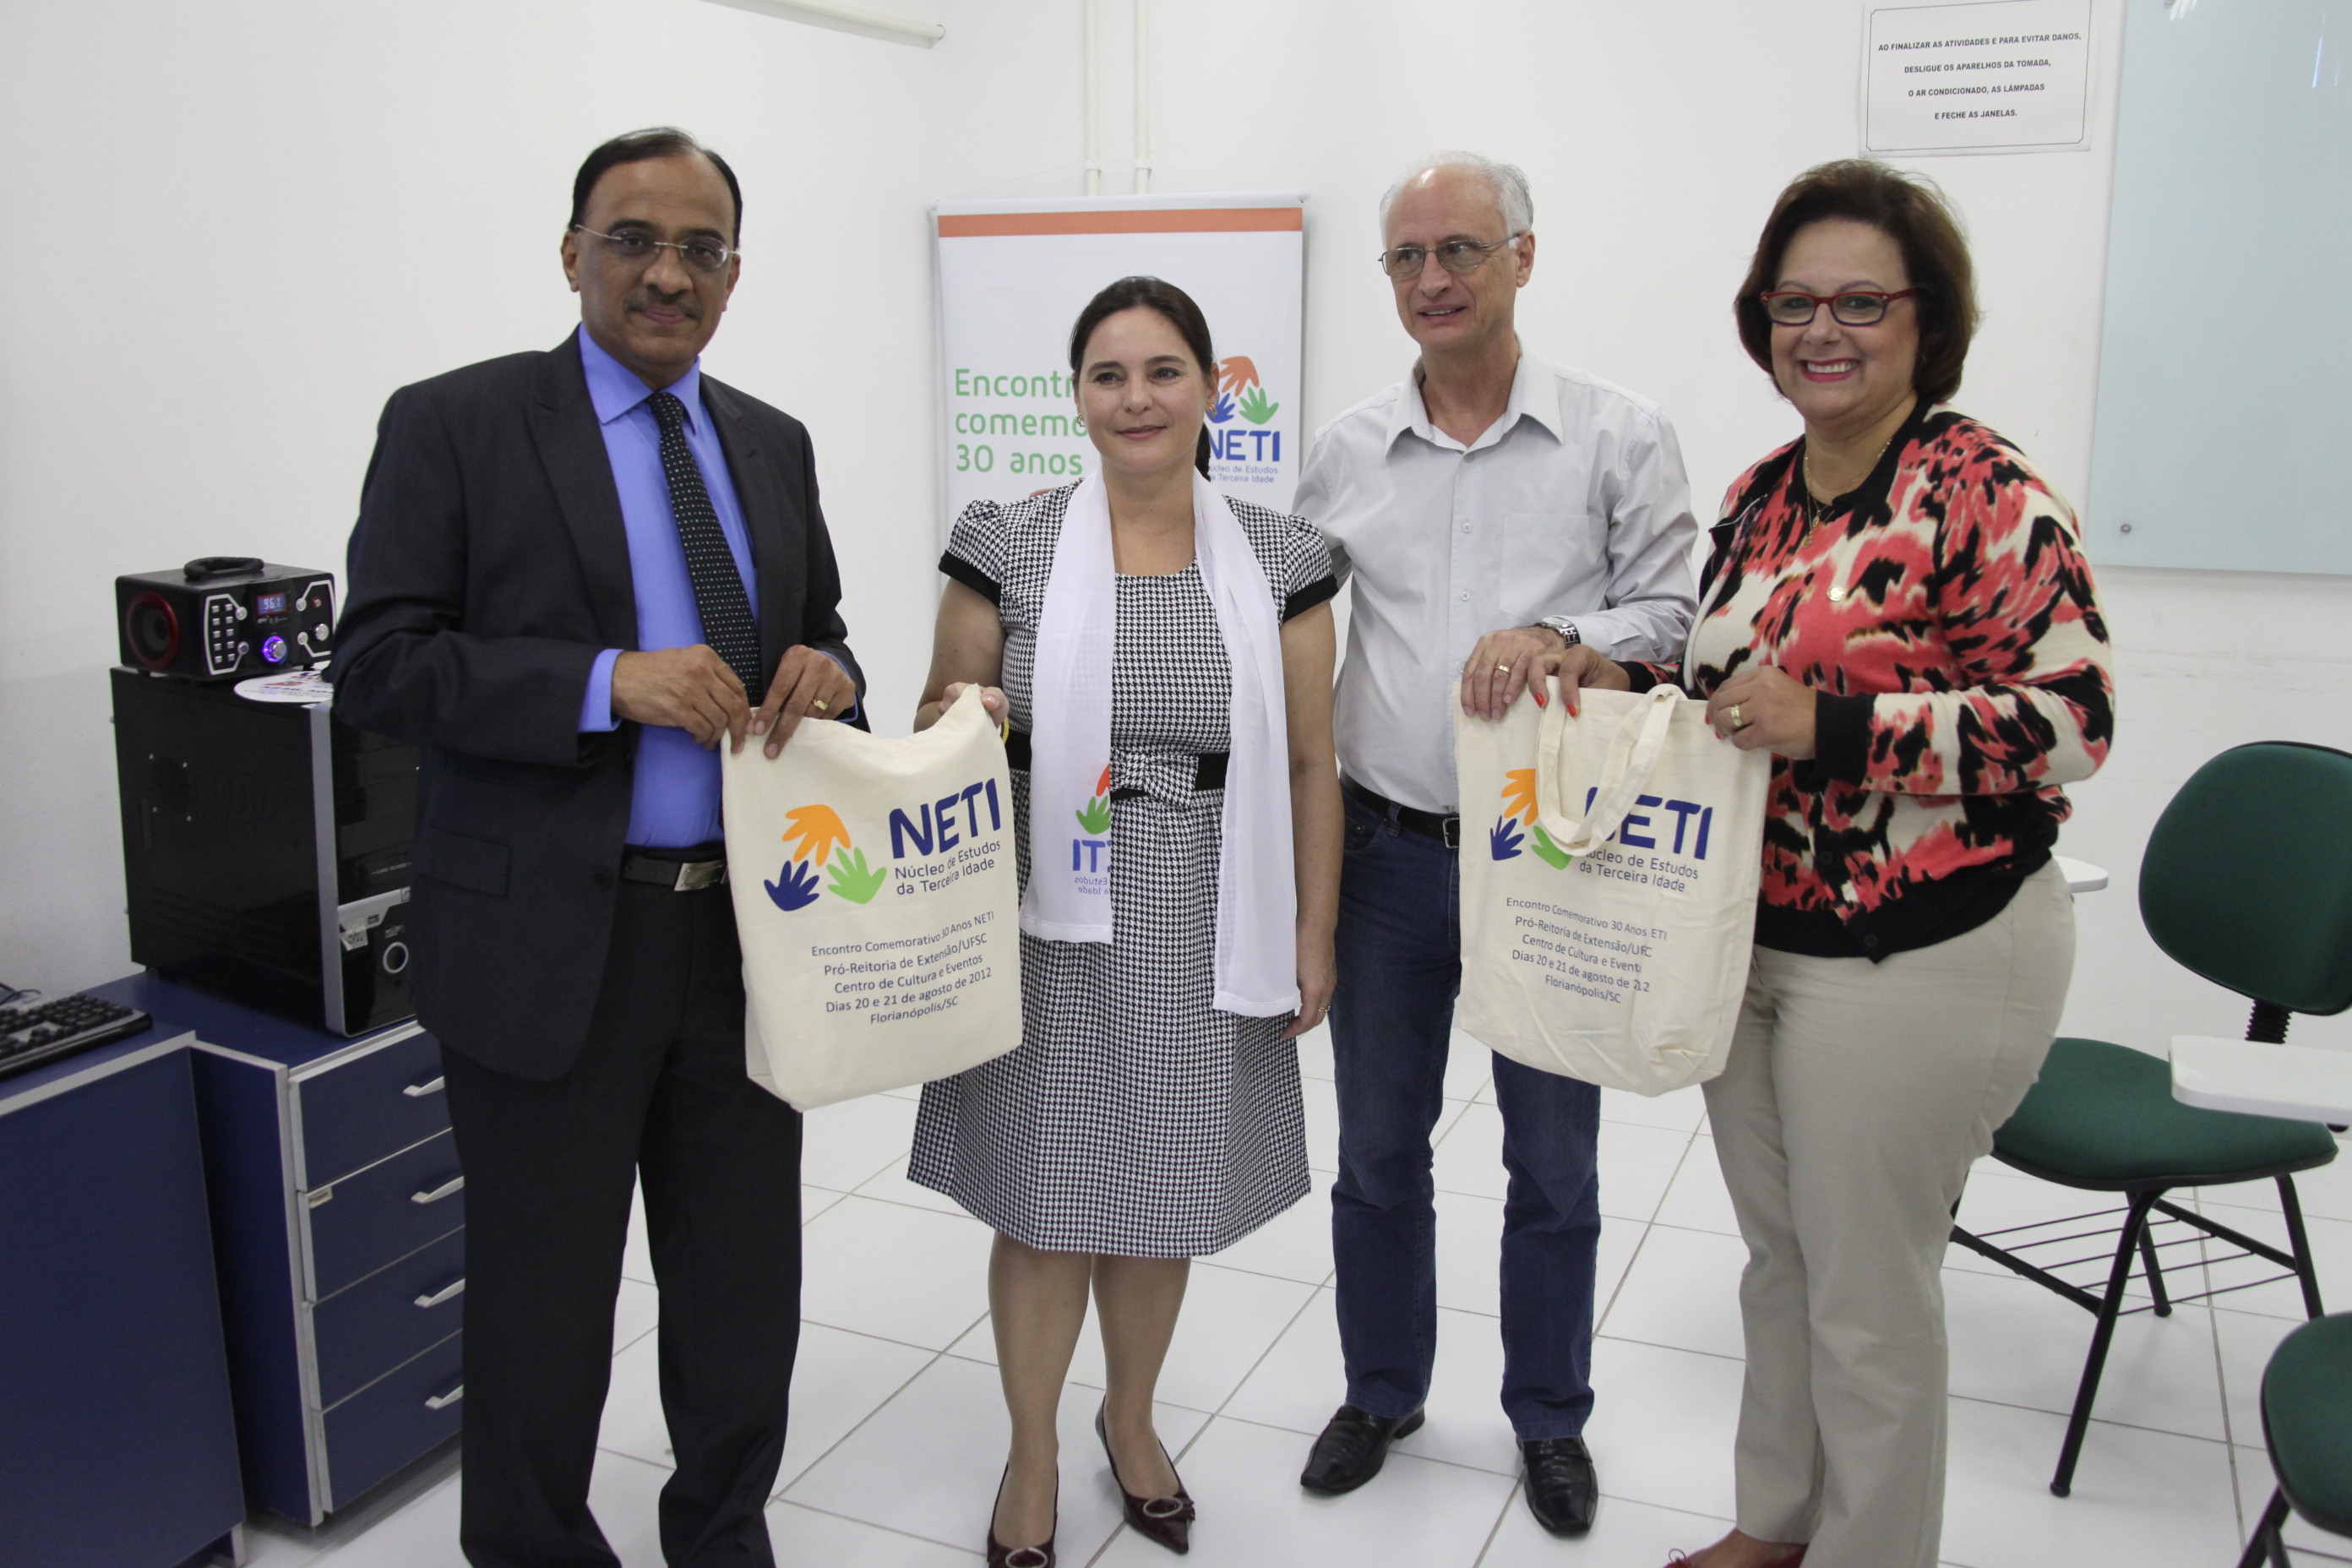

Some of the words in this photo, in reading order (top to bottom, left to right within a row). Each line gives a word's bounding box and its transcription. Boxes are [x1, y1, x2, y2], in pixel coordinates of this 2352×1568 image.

[1892, 41, 1930, 51] FINALIZAR
[1945, 37, 1990, 47] ATIVIDADES
[2022, 35, 2050, 43] EVITAR
[2052, 33, 2081, 41] DANOS,
[1904, 64, 1941, 73] DESLIGUE
[1957, 61, 2001, 70] APARELHOS
[2017, 59, 2051, 68] TOMADA,
[1929, 87, 1989, 95] CONDICIONADO,
[2004, 84, 2044, 92] LÂMPADAS
[1981, 109, 2017, 117] JANELAS.
[956, 369, 1073, 397] Encontr
[956, 413, 1088, 437] comemo
[956, 444, 994, 472] 30
[1010, 453, 1082, 475] anos
[889, 778, 1000, 858] NETI
[895, 864, 945, 879] Núcleo
[948, 856, 955, 869] de
[958, 840, 1000, 863] Estudos
[1628, 854, 1643, 868] de
[1650, 858, 1698, 879] Estudos
[896, 882, 914, 895] da
[919, 872, 959, 892] Terceira
[962, 858, 994, 876] Idade
[1580, 861, 1592, 873] da
[1597, 864, 1647, 884] Terceira
[1652, 874, 1685, 892] Idade
[812, 944, 862, 956] Encontro
[865, 933, 940, 951] Comemorativo
[942, 928, 949, 939] 30
[951, 920, 972, 934] Anos
[974, 912, 994, 927] NETI
[1506, 897, 1550, 912] Encontro
[1552, 905, 1608, 928] Comemorativo
[1611, 921, 1622, 931] 30
[1625, 923, 1647, 936] Anos
[1651, 929, 1667, 940] ETI
[1516, 917, 1571, 938] Pró-Reitoria
[1572, 930, 1582, 941] de
[825, 961, 896, 975] Pró-Reitoria
[900, 957, 913, 969] de
[917, 933, 988, 966] Extensão/UFSC
[1522, 934, 1553, 950] Centro
[1555, 943, 1565, 954] de
[1568, 946, 1598, 965] Cultura
[1610, 955, 1641, 972] Event
[835, 982, 875, 993] Centro
[879, 978, 894, 988] de
[897, 972, 936, 986] Cultura
[946, 955, 983, 972] Eventos
[1512, 950, 1534, 962] Dias
[1537, 955, 1547, 966] 20
[1556, 961, 1566, 972] 21
[1569, 965, 1579, 975] de
[1582, 971, 1614, 988] agosto
[1617, 978, 1629, 988] de
[826, 1001, 851, 1012] Dias
[855, 998, 869, 1009] 20
[873, 999, 879, 1007] e
[884, 995, 897, 1005] 21
[901, 992, 916, 1003] de
[919, 984, 952, 1001] agosto
[955, 978, 966, 989] de
[969, 967, 992, 984] 2012
[1545, 975, 1621, 1004] Florianópolis/SC
[870, 996, 958, 1024] Florianópolis/SC
